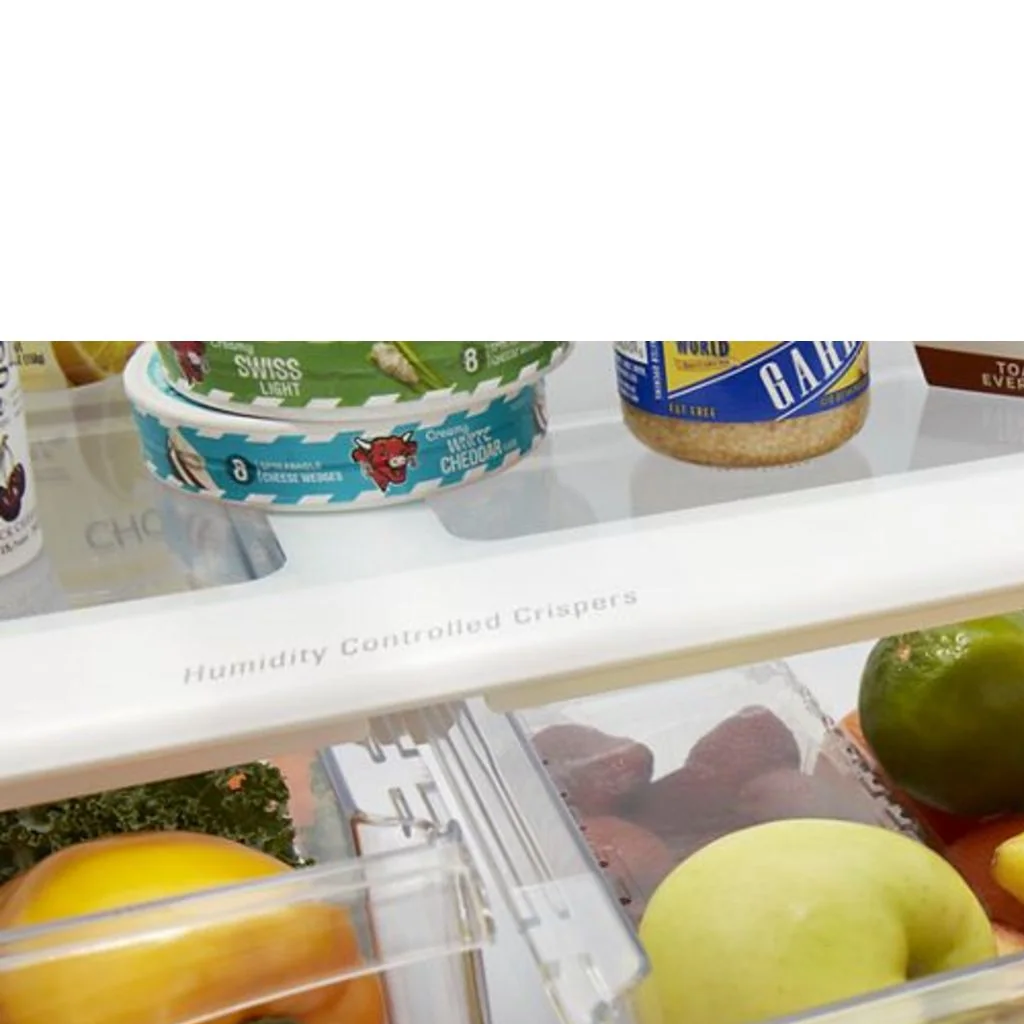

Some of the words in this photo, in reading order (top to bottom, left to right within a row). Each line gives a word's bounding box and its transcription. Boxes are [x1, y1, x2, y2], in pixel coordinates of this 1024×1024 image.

[234, 354, 302, 381] SWISS
[463, 346, 479, 373] 8
[258, 381, 301, 397] LIGHT
[440, 438, 503, 475] CHEDDAR
[183, 645, 328, 685] Humidity
[340, 612, 502, 657] Controlled
[512, 589, 639, 626] Crispers
